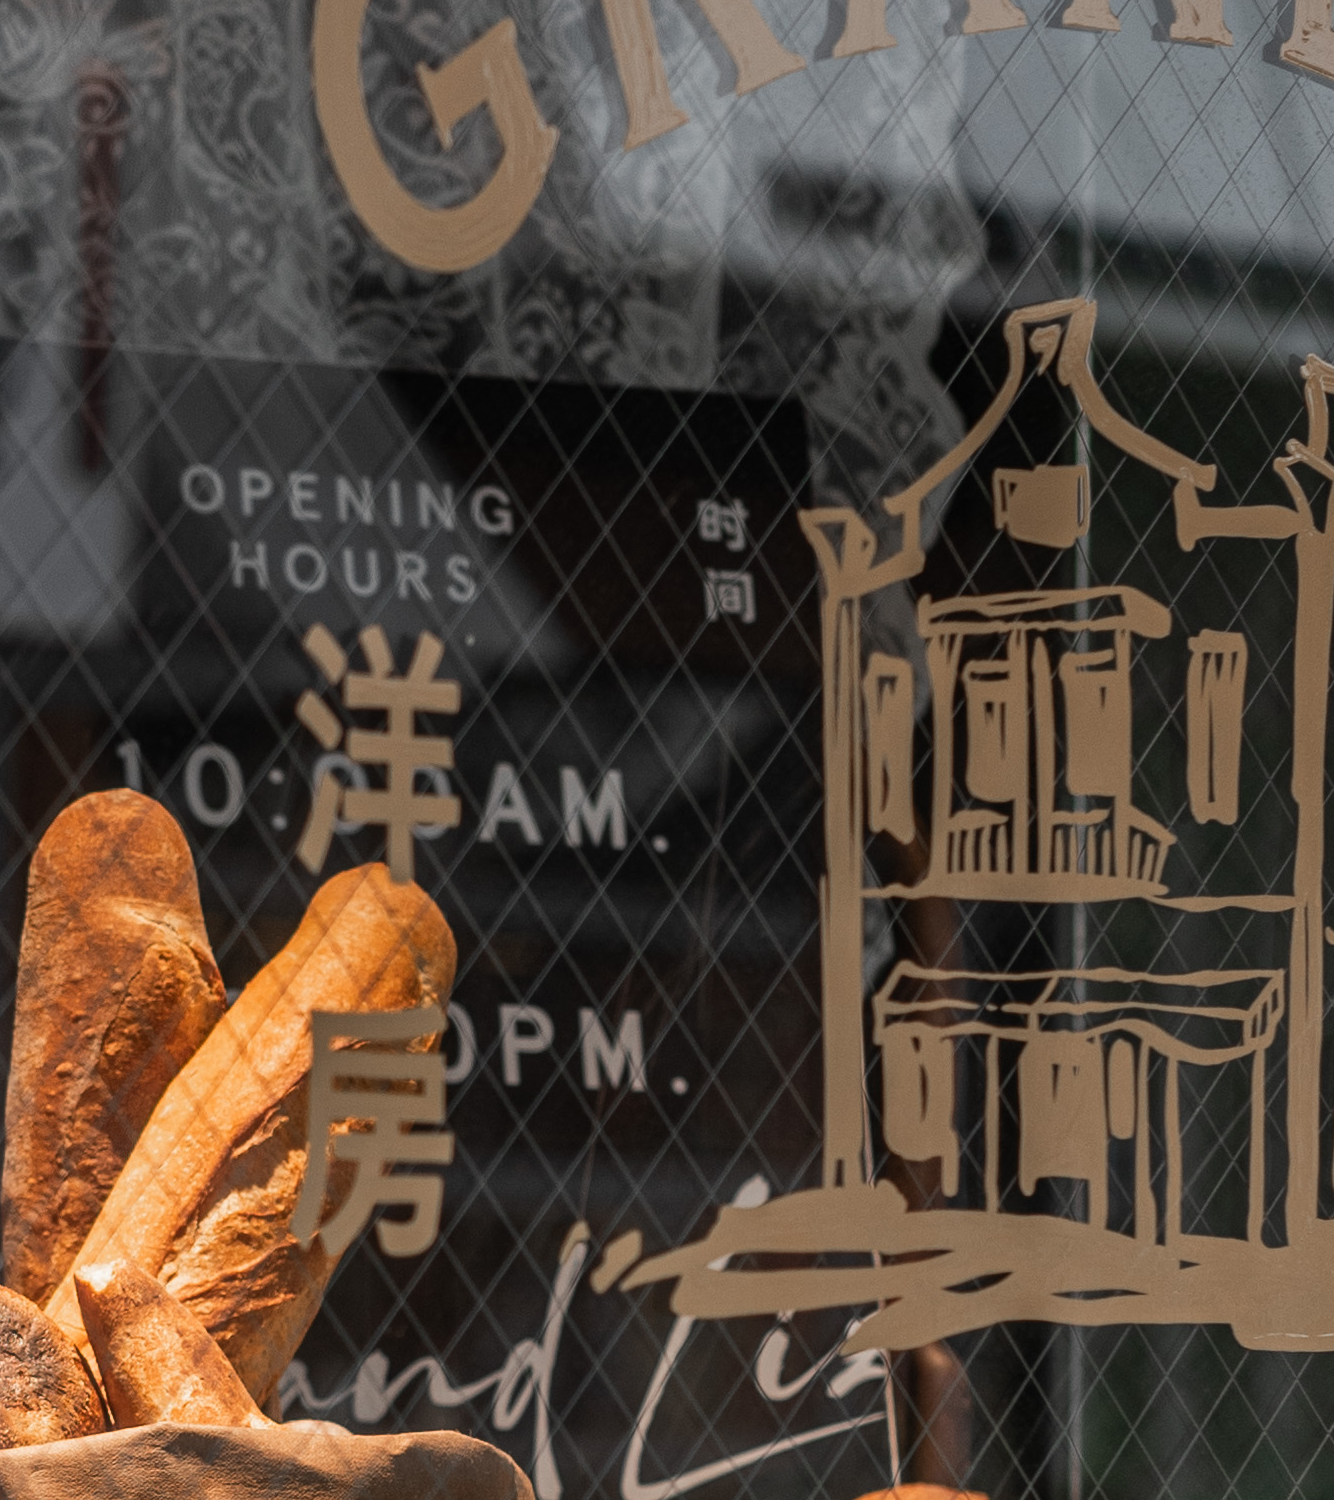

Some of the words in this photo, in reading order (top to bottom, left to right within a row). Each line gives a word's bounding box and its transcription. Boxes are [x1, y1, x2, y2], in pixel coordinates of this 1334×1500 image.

[180, 463, 515, 536] OPENING
[230, 540, 477, 603] HOURS
[697, 498, 757, 624] 时间
[290, 621, 462, 1258] 洋房
